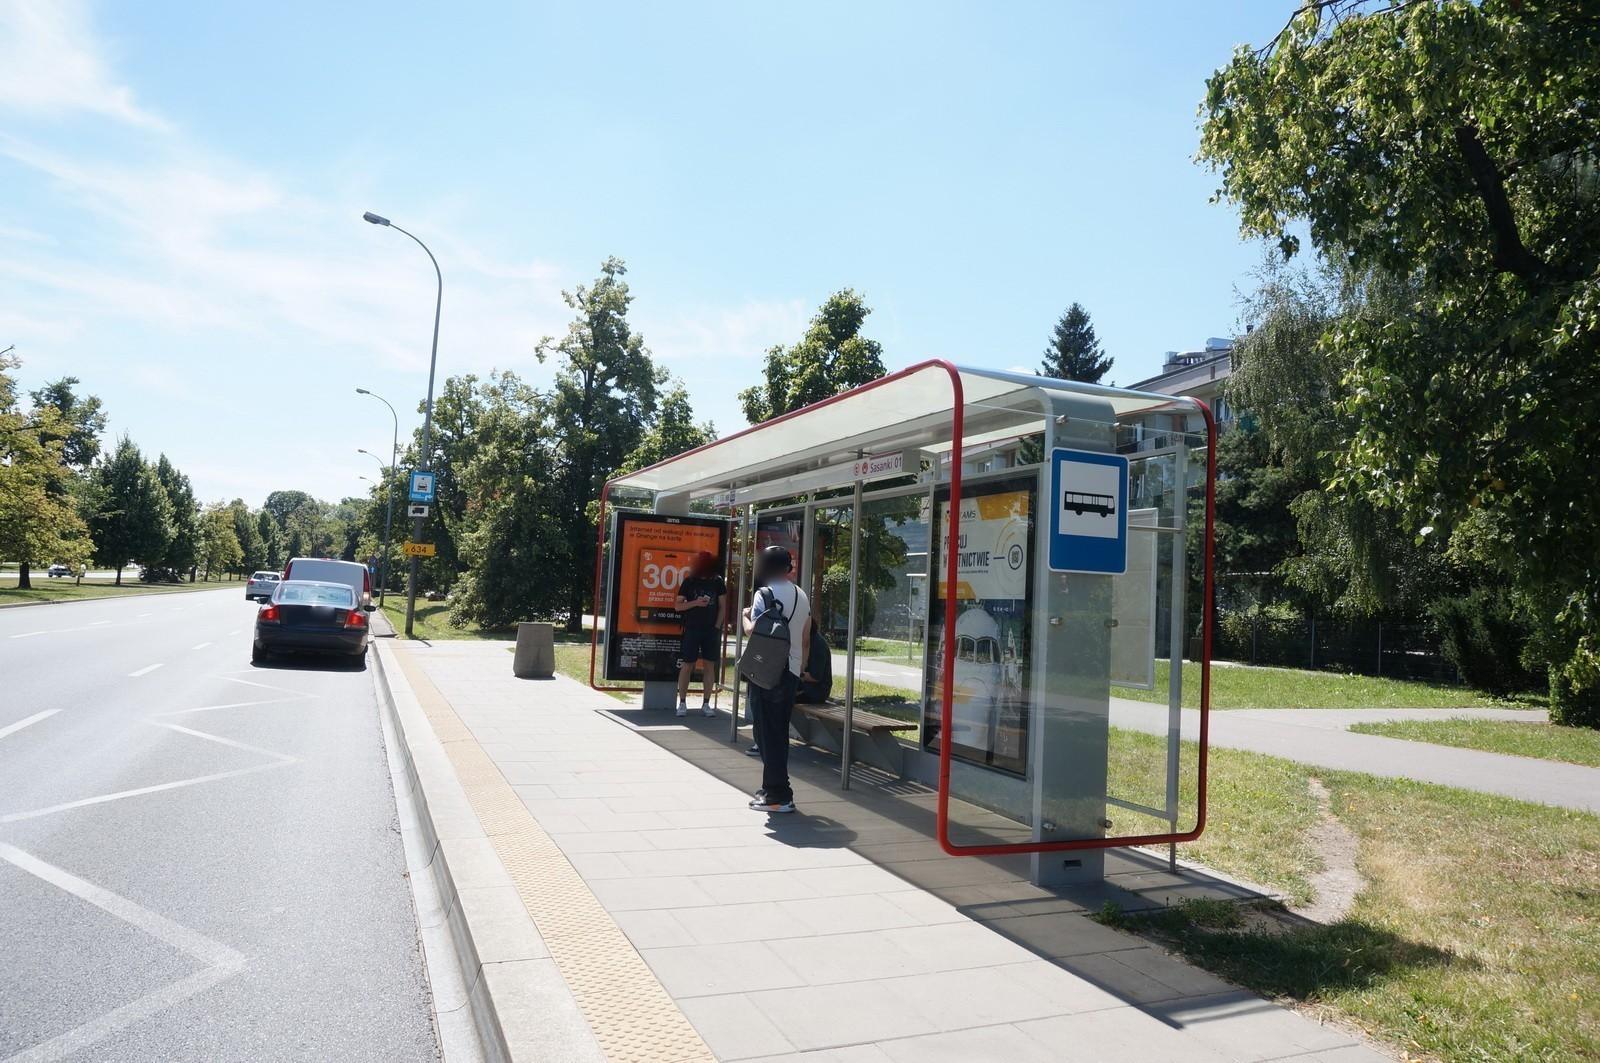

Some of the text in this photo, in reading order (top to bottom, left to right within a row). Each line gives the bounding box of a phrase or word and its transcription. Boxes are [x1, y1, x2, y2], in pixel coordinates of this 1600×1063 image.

[870, 456, 902, 473] Sasanki 01
[411, 544, 427, 554] 634
[943, 534, 967, 550] PUJ
[957, 551, 990, 567] TNICTWIE
